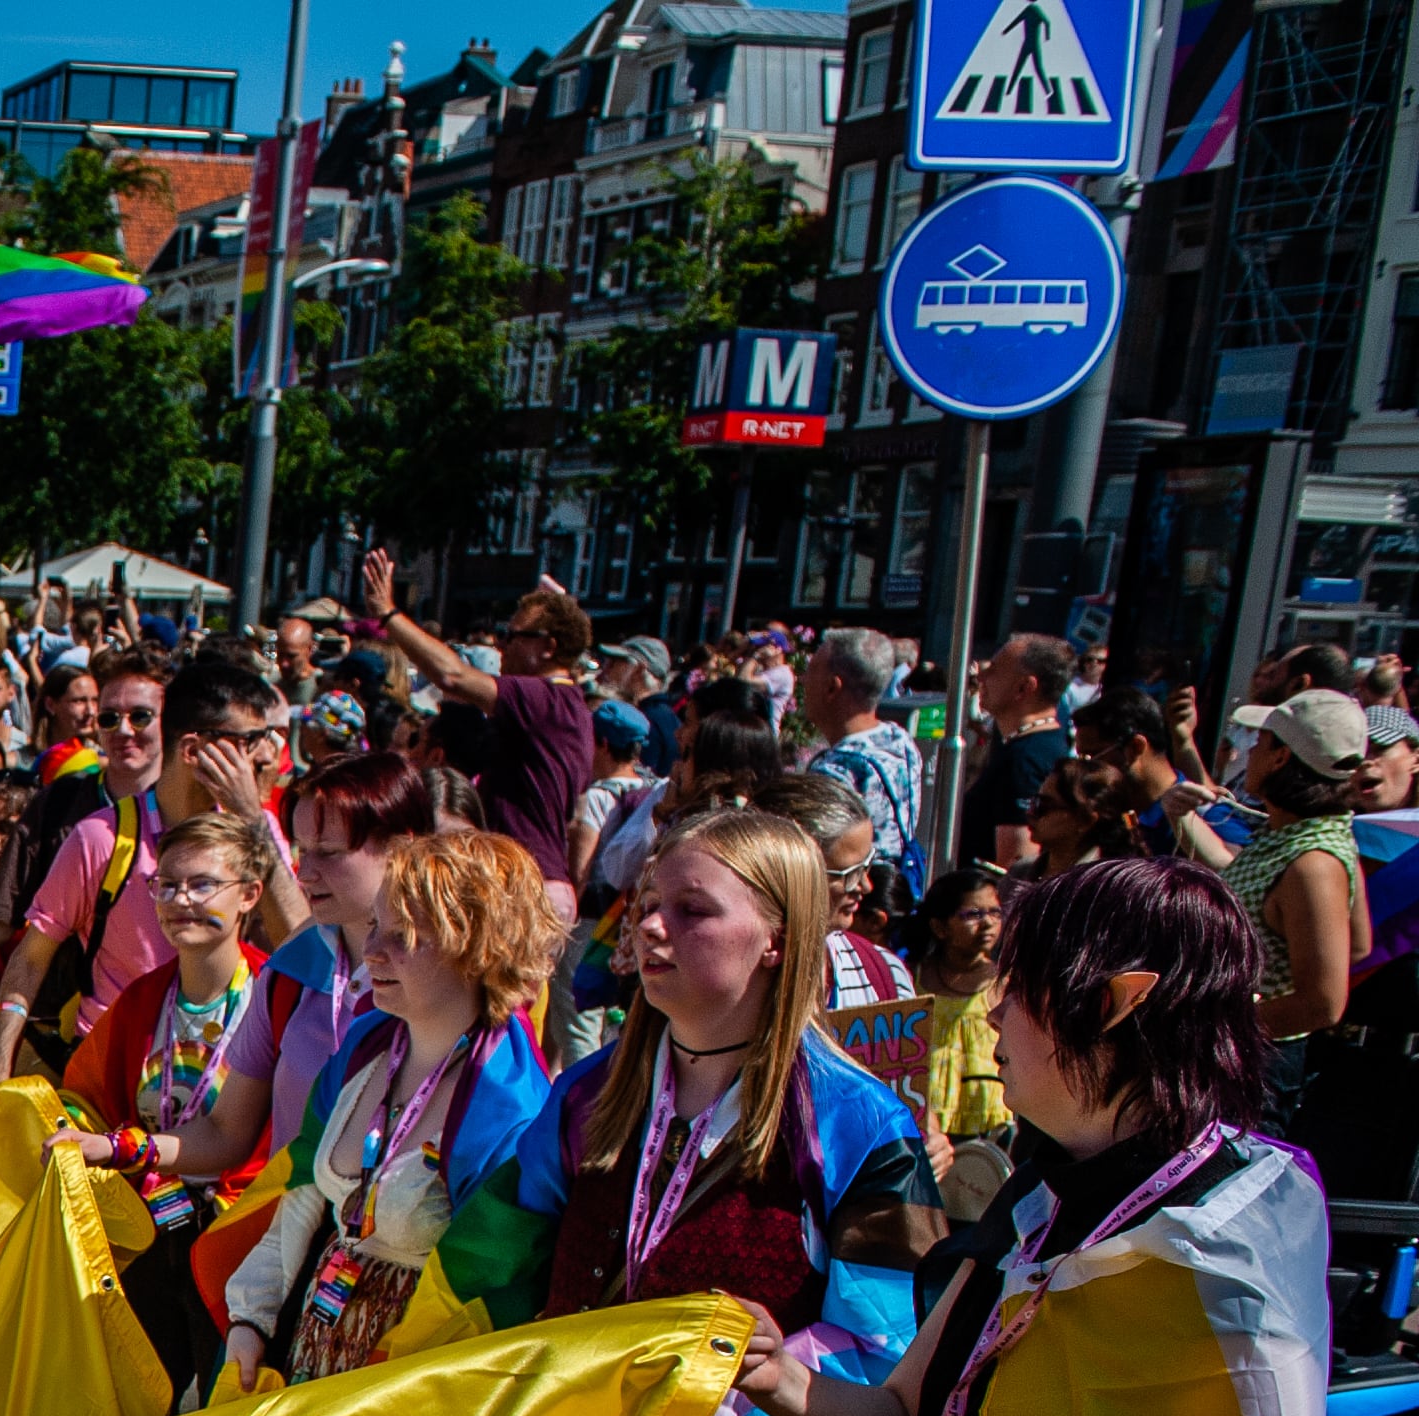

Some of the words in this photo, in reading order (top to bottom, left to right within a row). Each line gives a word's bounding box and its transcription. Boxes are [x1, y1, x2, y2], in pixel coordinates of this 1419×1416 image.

[693, 339, 730, 408] M
[746, 337, 819, 408] M
[832, 1010, 928, 1065] ANS
[1167, 1150, 1197, 1179] family
[1122, 1201, 1138, 1216] are
[1138, 1190, 1154, 1202] We
